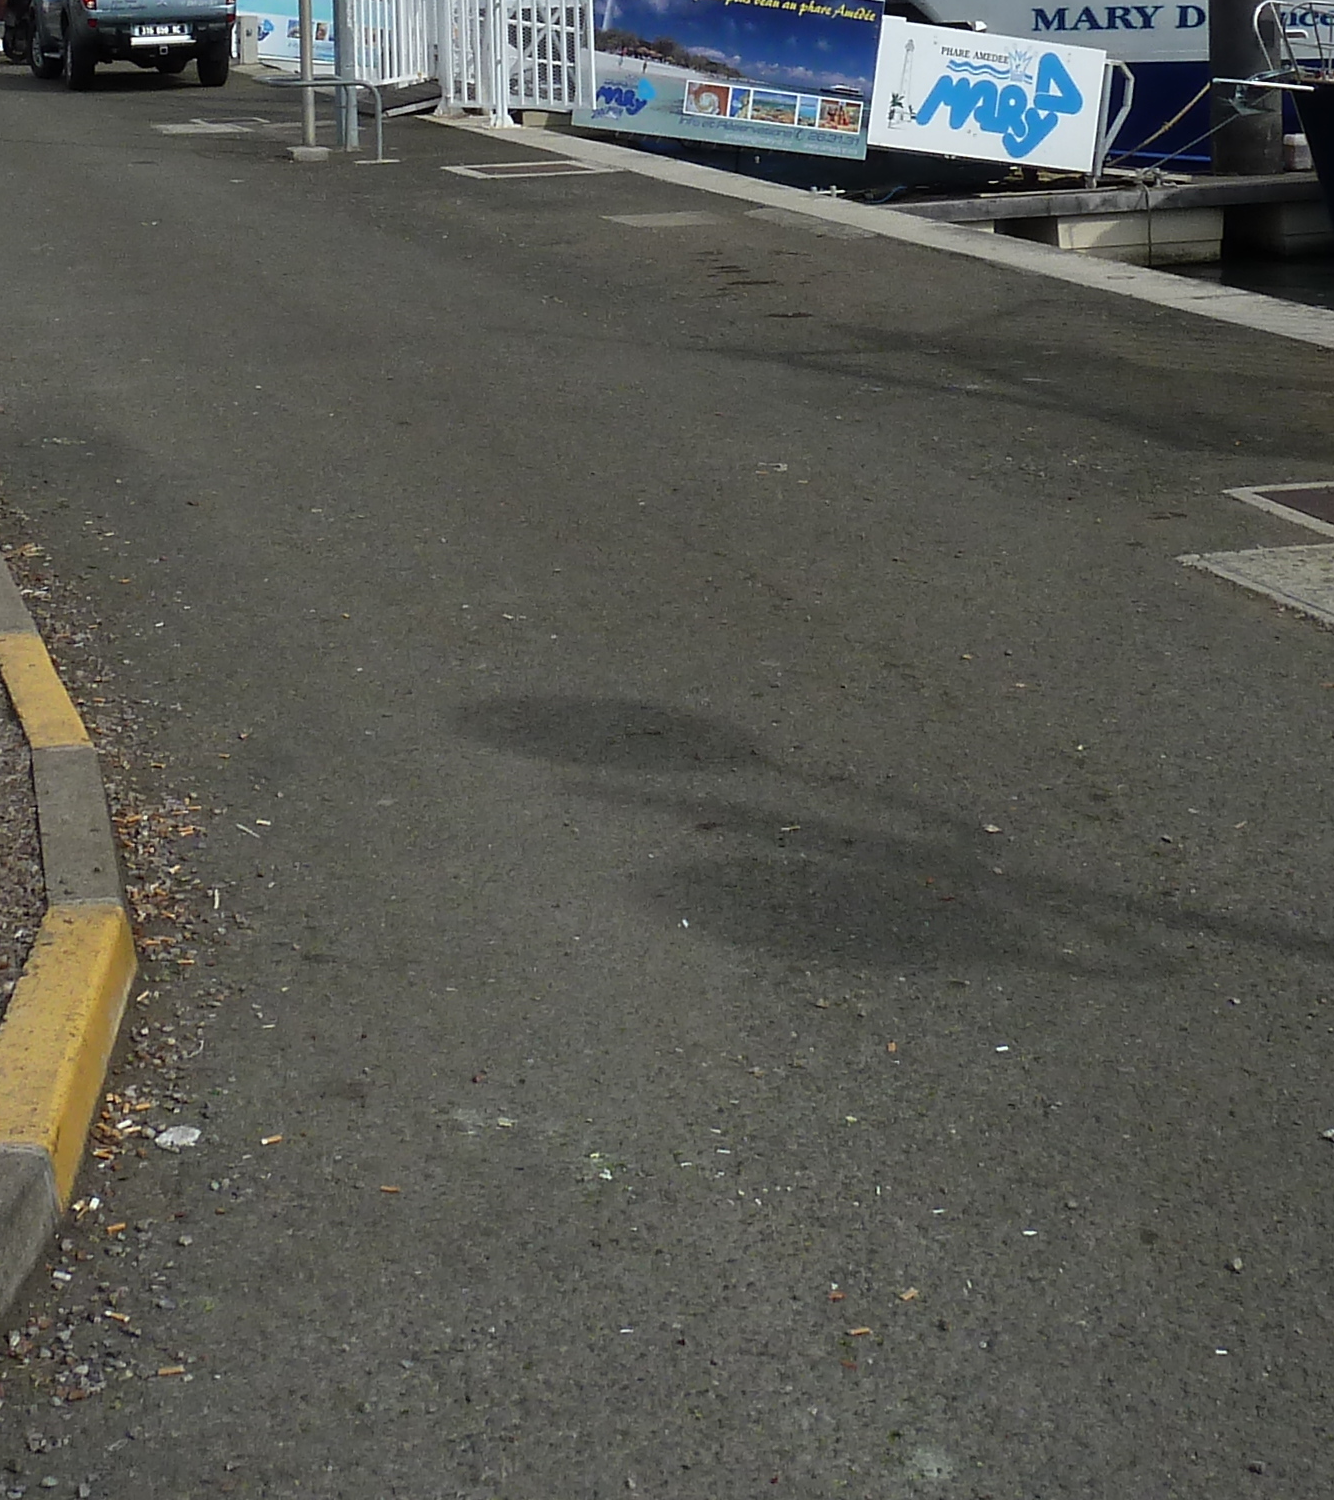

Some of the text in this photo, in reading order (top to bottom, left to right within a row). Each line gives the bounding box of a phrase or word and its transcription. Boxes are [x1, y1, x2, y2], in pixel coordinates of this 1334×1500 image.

[781, 0, 798, 10] au
[798, 0, 833, 17] phare
[1031, 5, 1165, 32] MARY
[1174, 4, 1207, 29] D
[941, 46, 1010, 64] PHARE AMEDEE
[916, 74, 1059, 159] MARY
